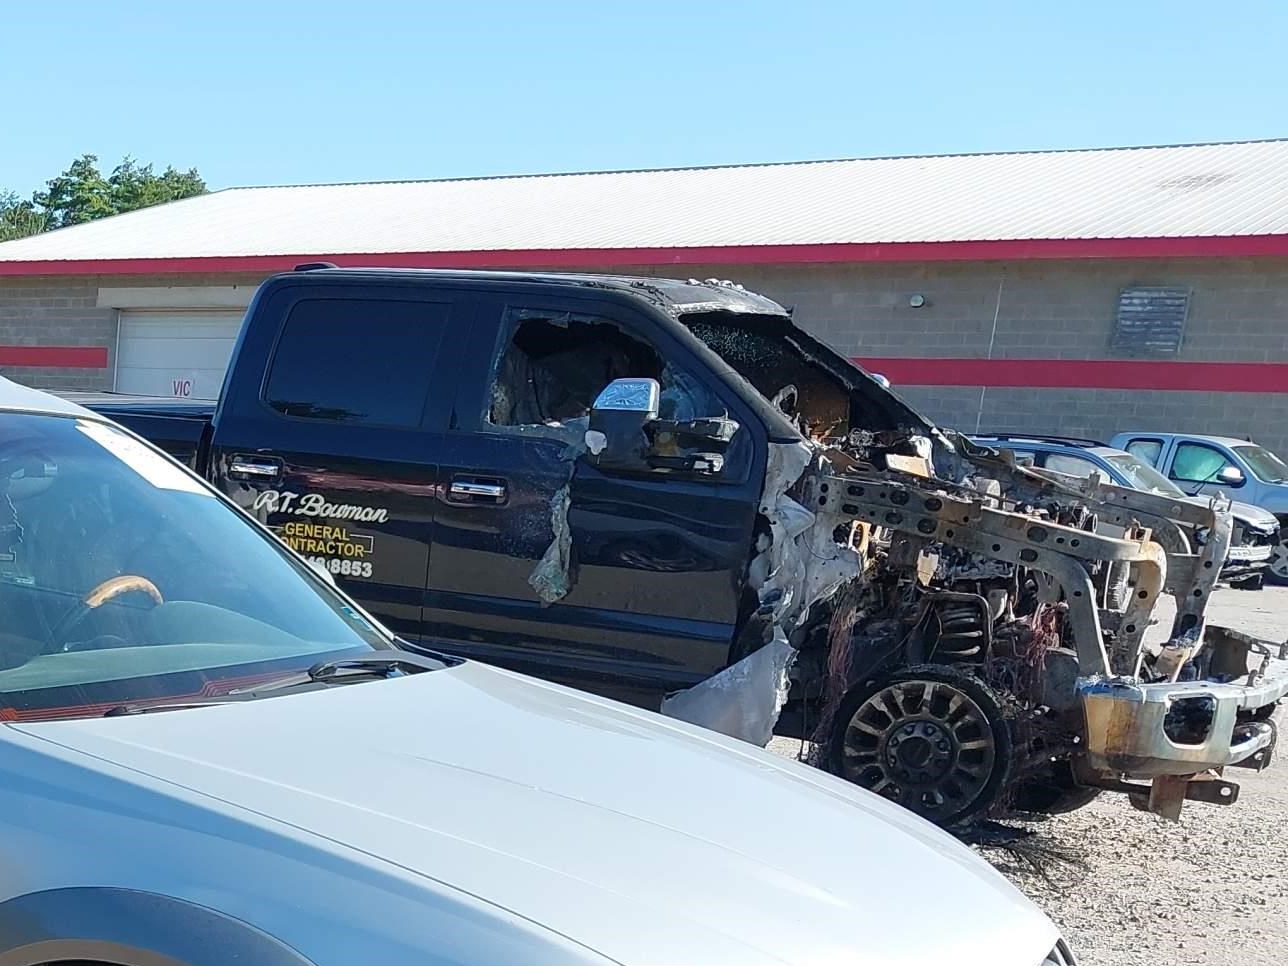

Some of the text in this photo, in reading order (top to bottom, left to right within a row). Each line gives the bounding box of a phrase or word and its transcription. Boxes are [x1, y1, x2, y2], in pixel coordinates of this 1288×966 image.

[173, 380, 191, 397] VIC
[253, 489, 389, 523] R.T. Bowman
[284, 522, 350, 541] GENERAL
[280, 536, 364, 558] ONTRACTOR
